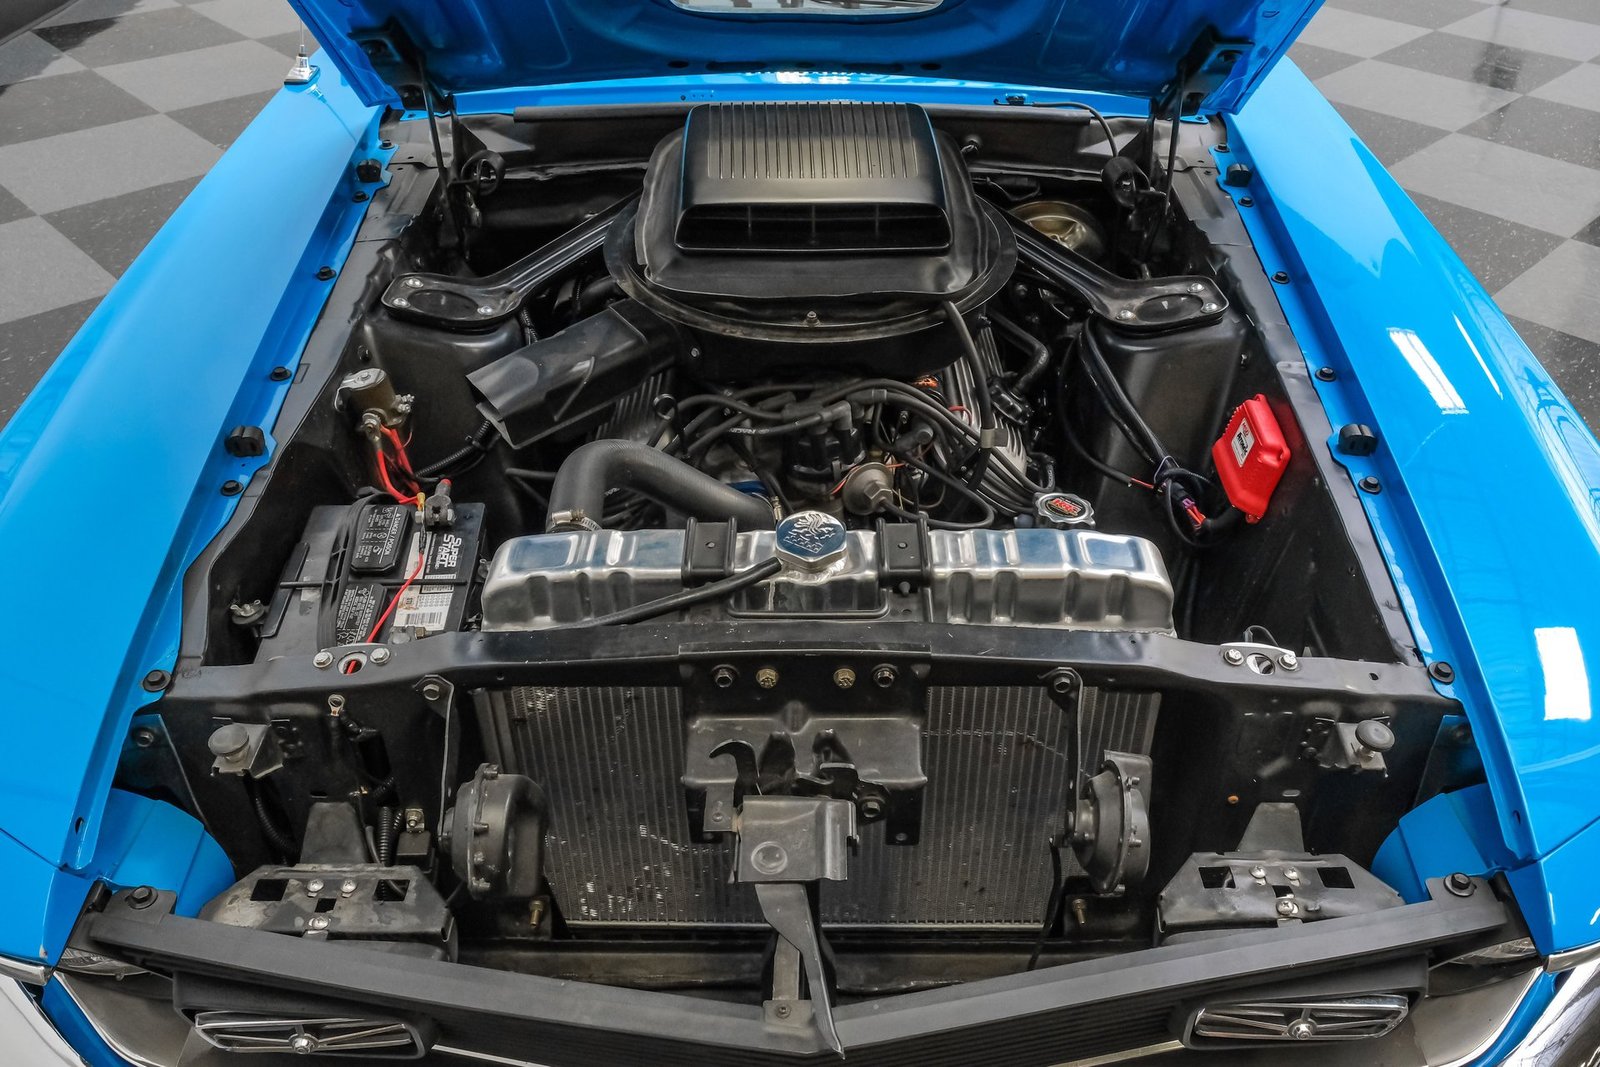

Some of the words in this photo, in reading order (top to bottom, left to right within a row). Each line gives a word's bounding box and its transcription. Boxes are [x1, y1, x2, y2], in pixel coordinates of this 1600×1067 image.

[391, 517, 401, 534] DANGER
[384, 538, 395, 556] POISON
[439, 533, 455, 568] START
[447, 537, 462, 568] SUPER
